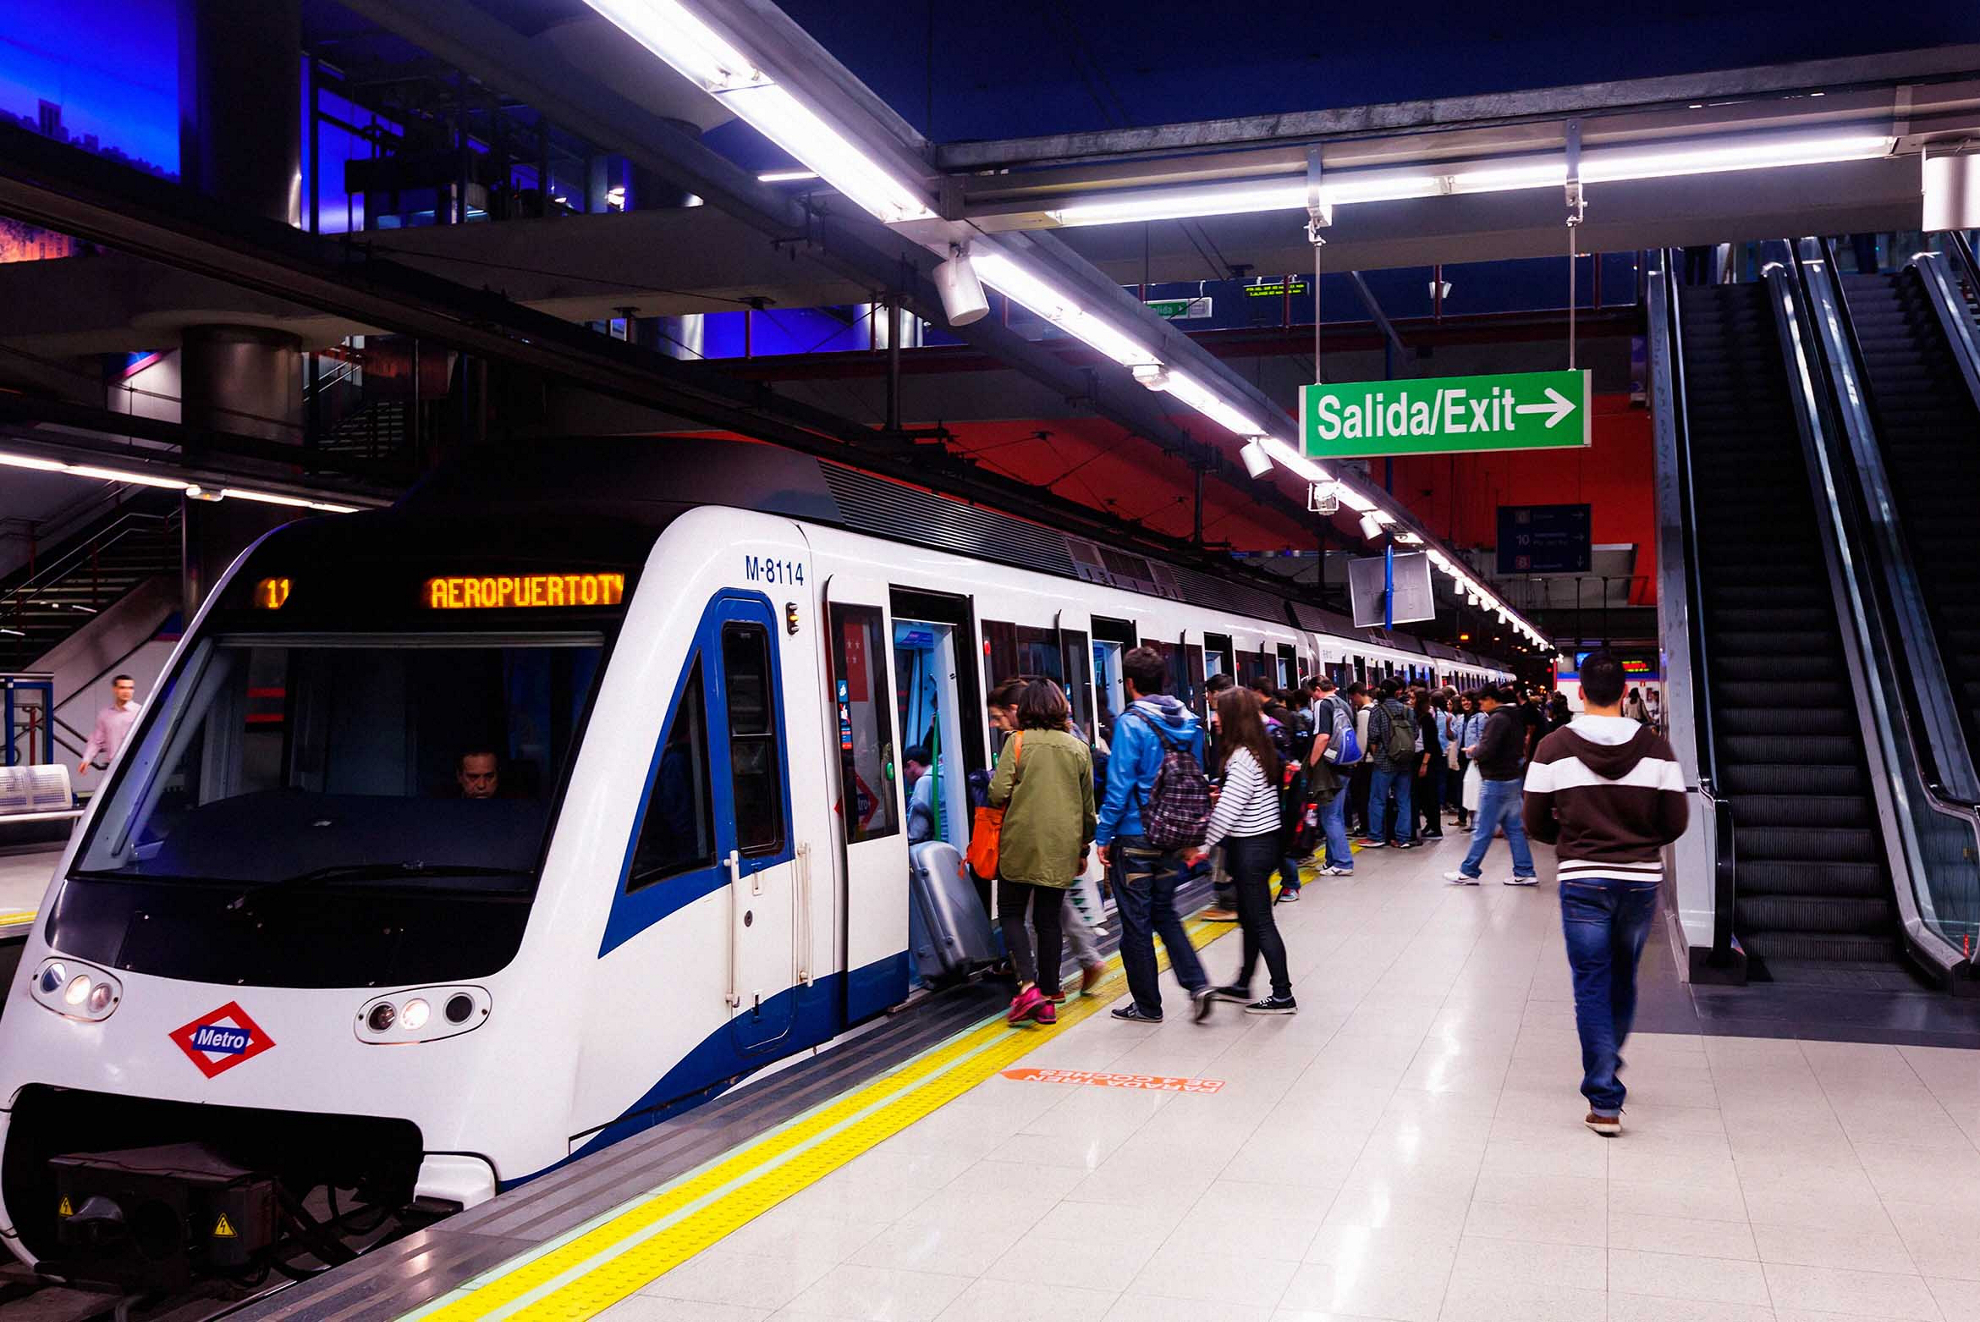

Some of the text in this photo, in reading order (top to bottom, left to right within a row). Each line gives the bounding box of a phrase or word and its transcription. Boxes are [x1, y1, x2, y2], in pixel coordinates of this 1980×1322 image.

[1318, 387, 1515, 440] Salida/Exit
[1515, 534, 1530, 546] 10
[745, 555, 804, 586] M-8114
[267, 579, 289, 608] 11
[197, 1028, 245, 1049] Metro
[1106, 1080, 1219, 1093] PARADA
